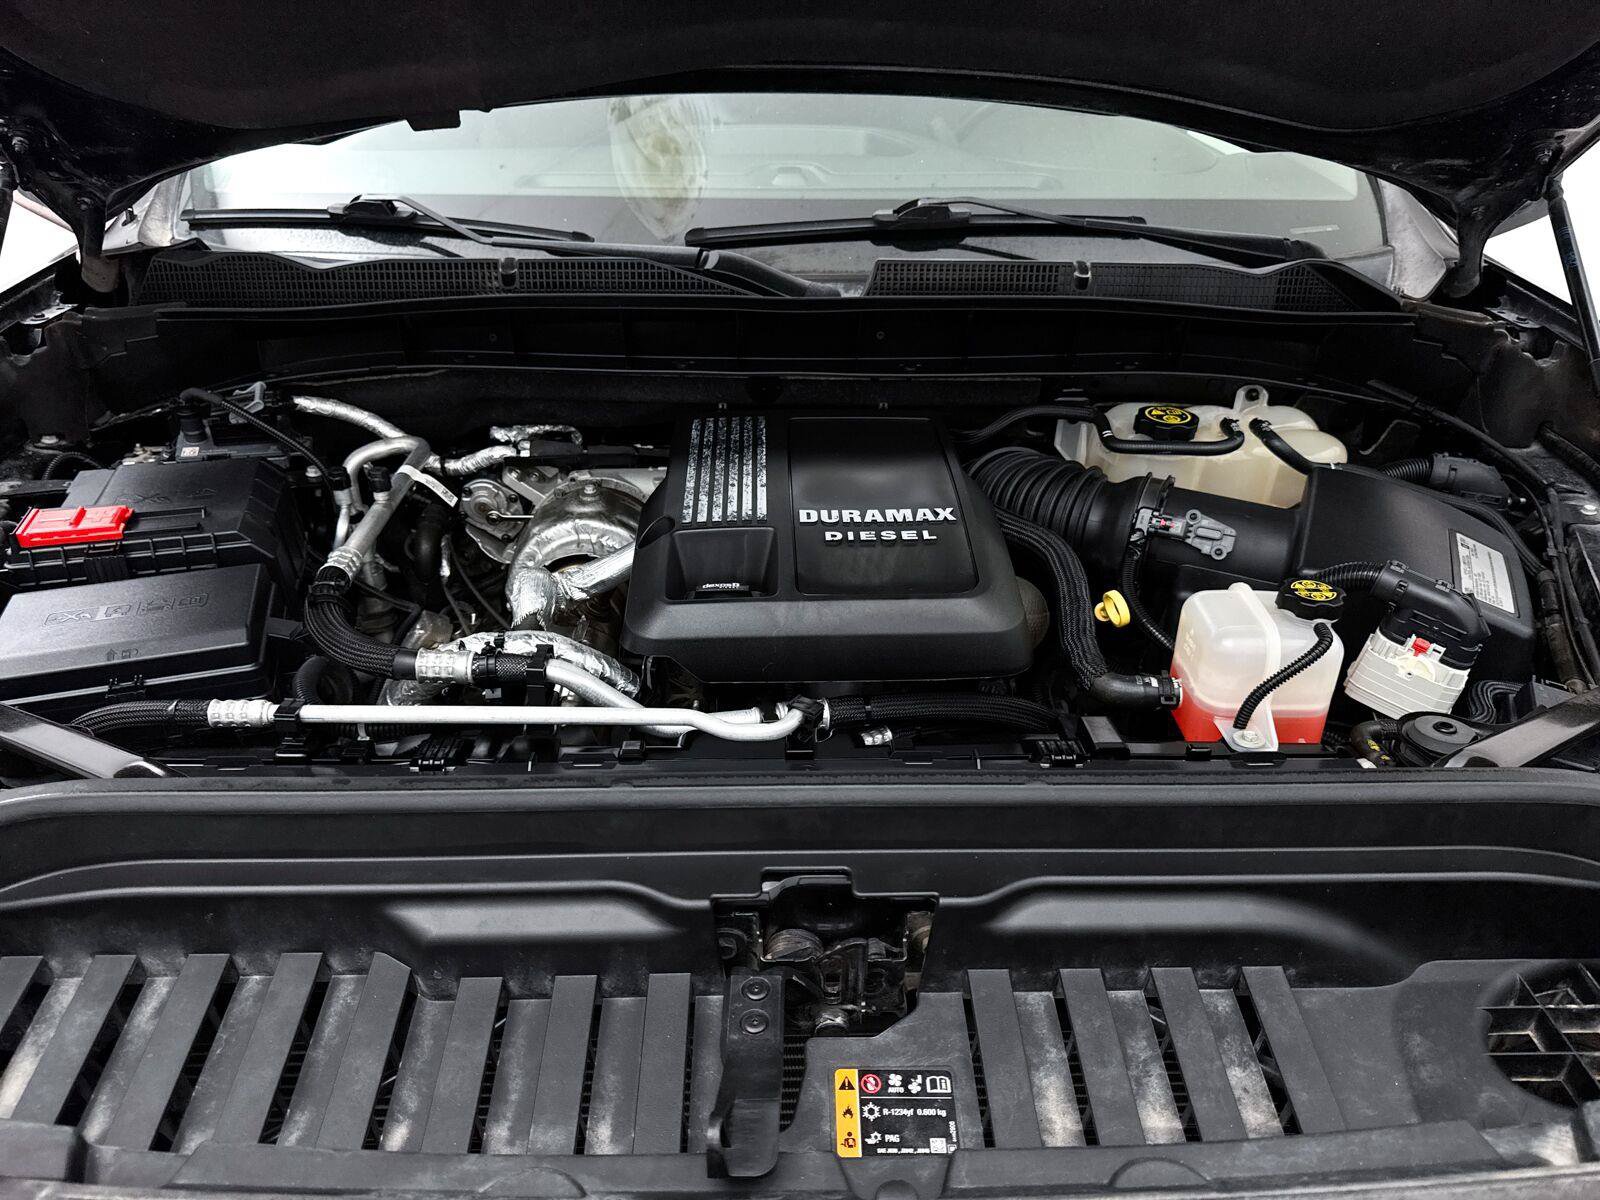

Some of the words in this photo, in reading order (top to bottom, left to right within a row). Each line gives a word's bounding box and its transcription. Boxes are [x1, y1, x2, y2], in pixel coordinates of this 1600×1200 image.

[799, 507, 957, 523] DURAMAX
[824, 529, 938, 541] DIESEL
[882, 1108, 914, 1117] R-1234yf
[937, 1108, 947, 1118] kg
[884, 1134, 900, 1143] PAG
